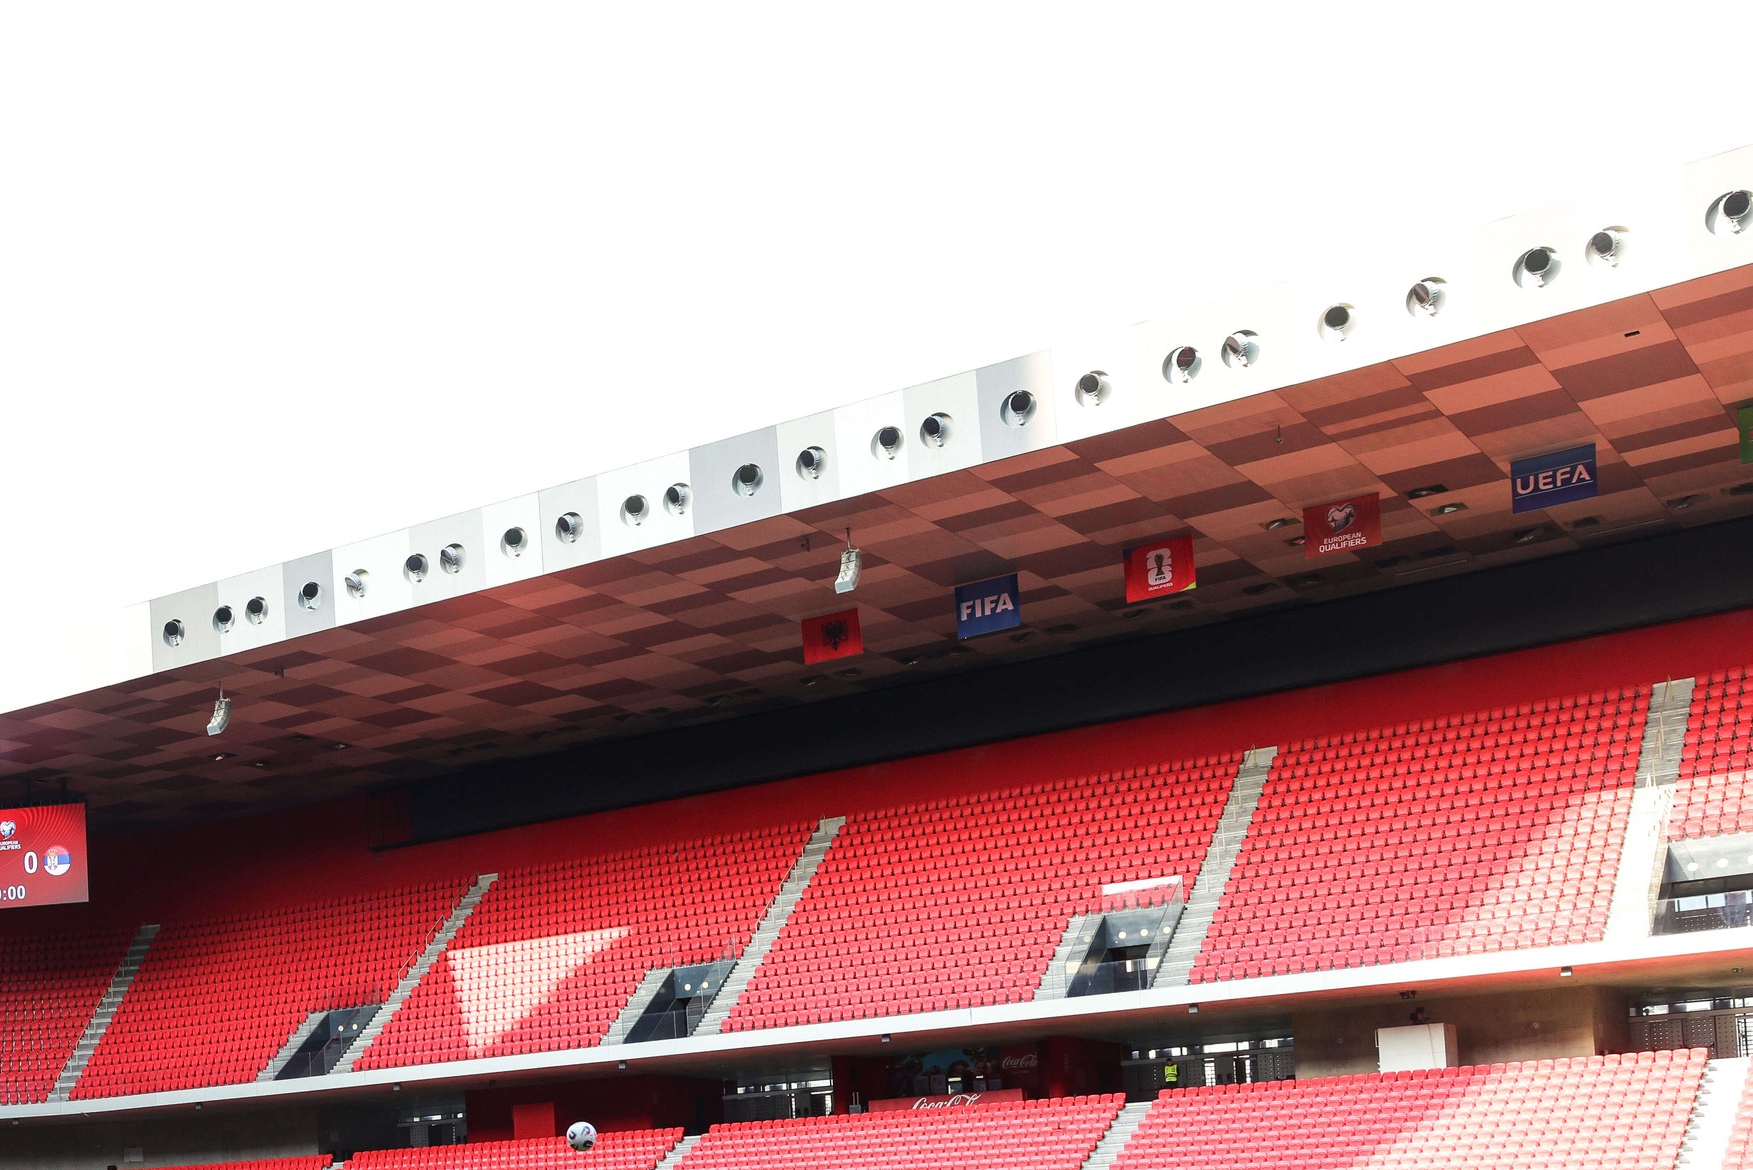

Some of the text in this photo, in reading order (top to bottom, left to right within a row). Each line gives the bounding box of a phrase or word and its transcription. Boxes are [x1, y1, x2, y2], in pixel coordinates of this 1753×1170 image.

[1516, 464, 1591, 495] UEFA
[1319, 537, 1367, 553] QUALIFIERS
[1323, 532, 1362, 544] EUROPEAN
[960, 592, 1015, 622] FIFA
[24, 851, 38, 874] 0
